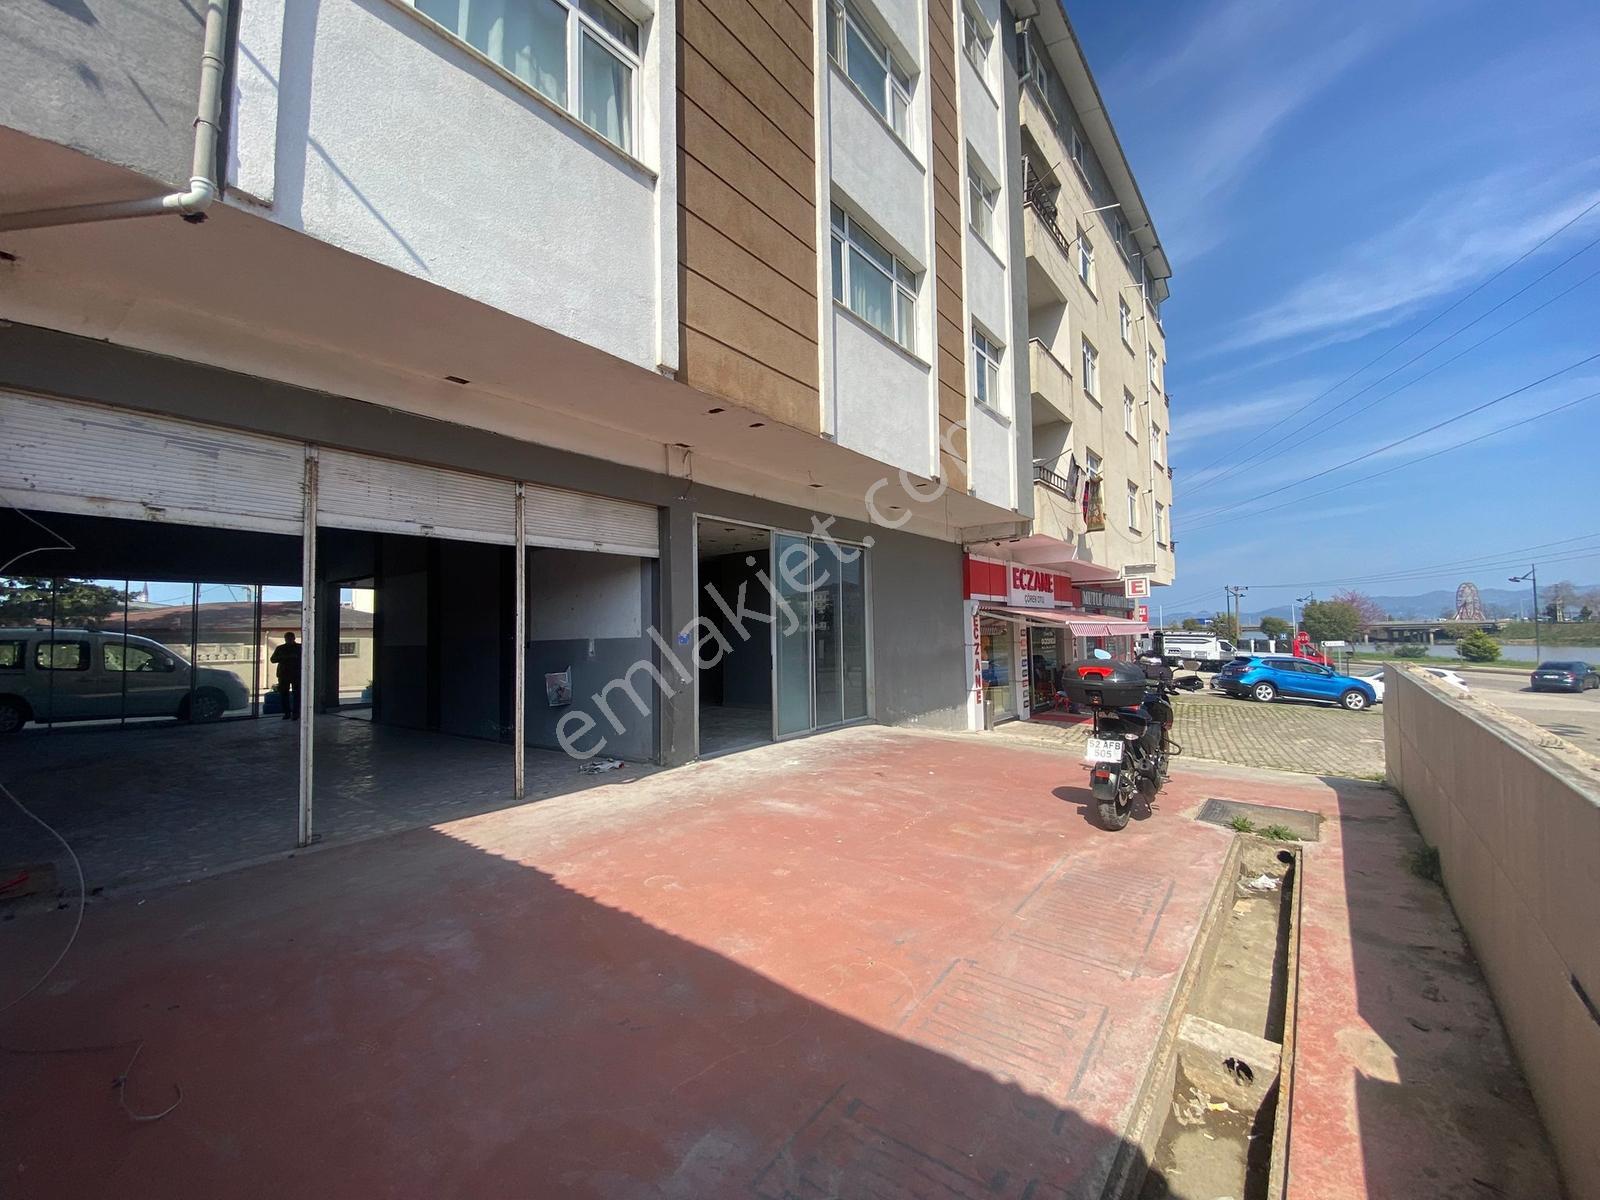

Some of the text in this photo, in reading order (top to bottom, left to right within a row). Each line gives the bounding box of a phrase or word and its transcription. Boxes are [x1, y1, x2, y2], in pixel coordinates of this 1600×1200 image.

[1012, 567, 1054, 593] ECZANE
[1131, 581, 1143, 594] E
[972, 614, 983, 705] ECZANE
